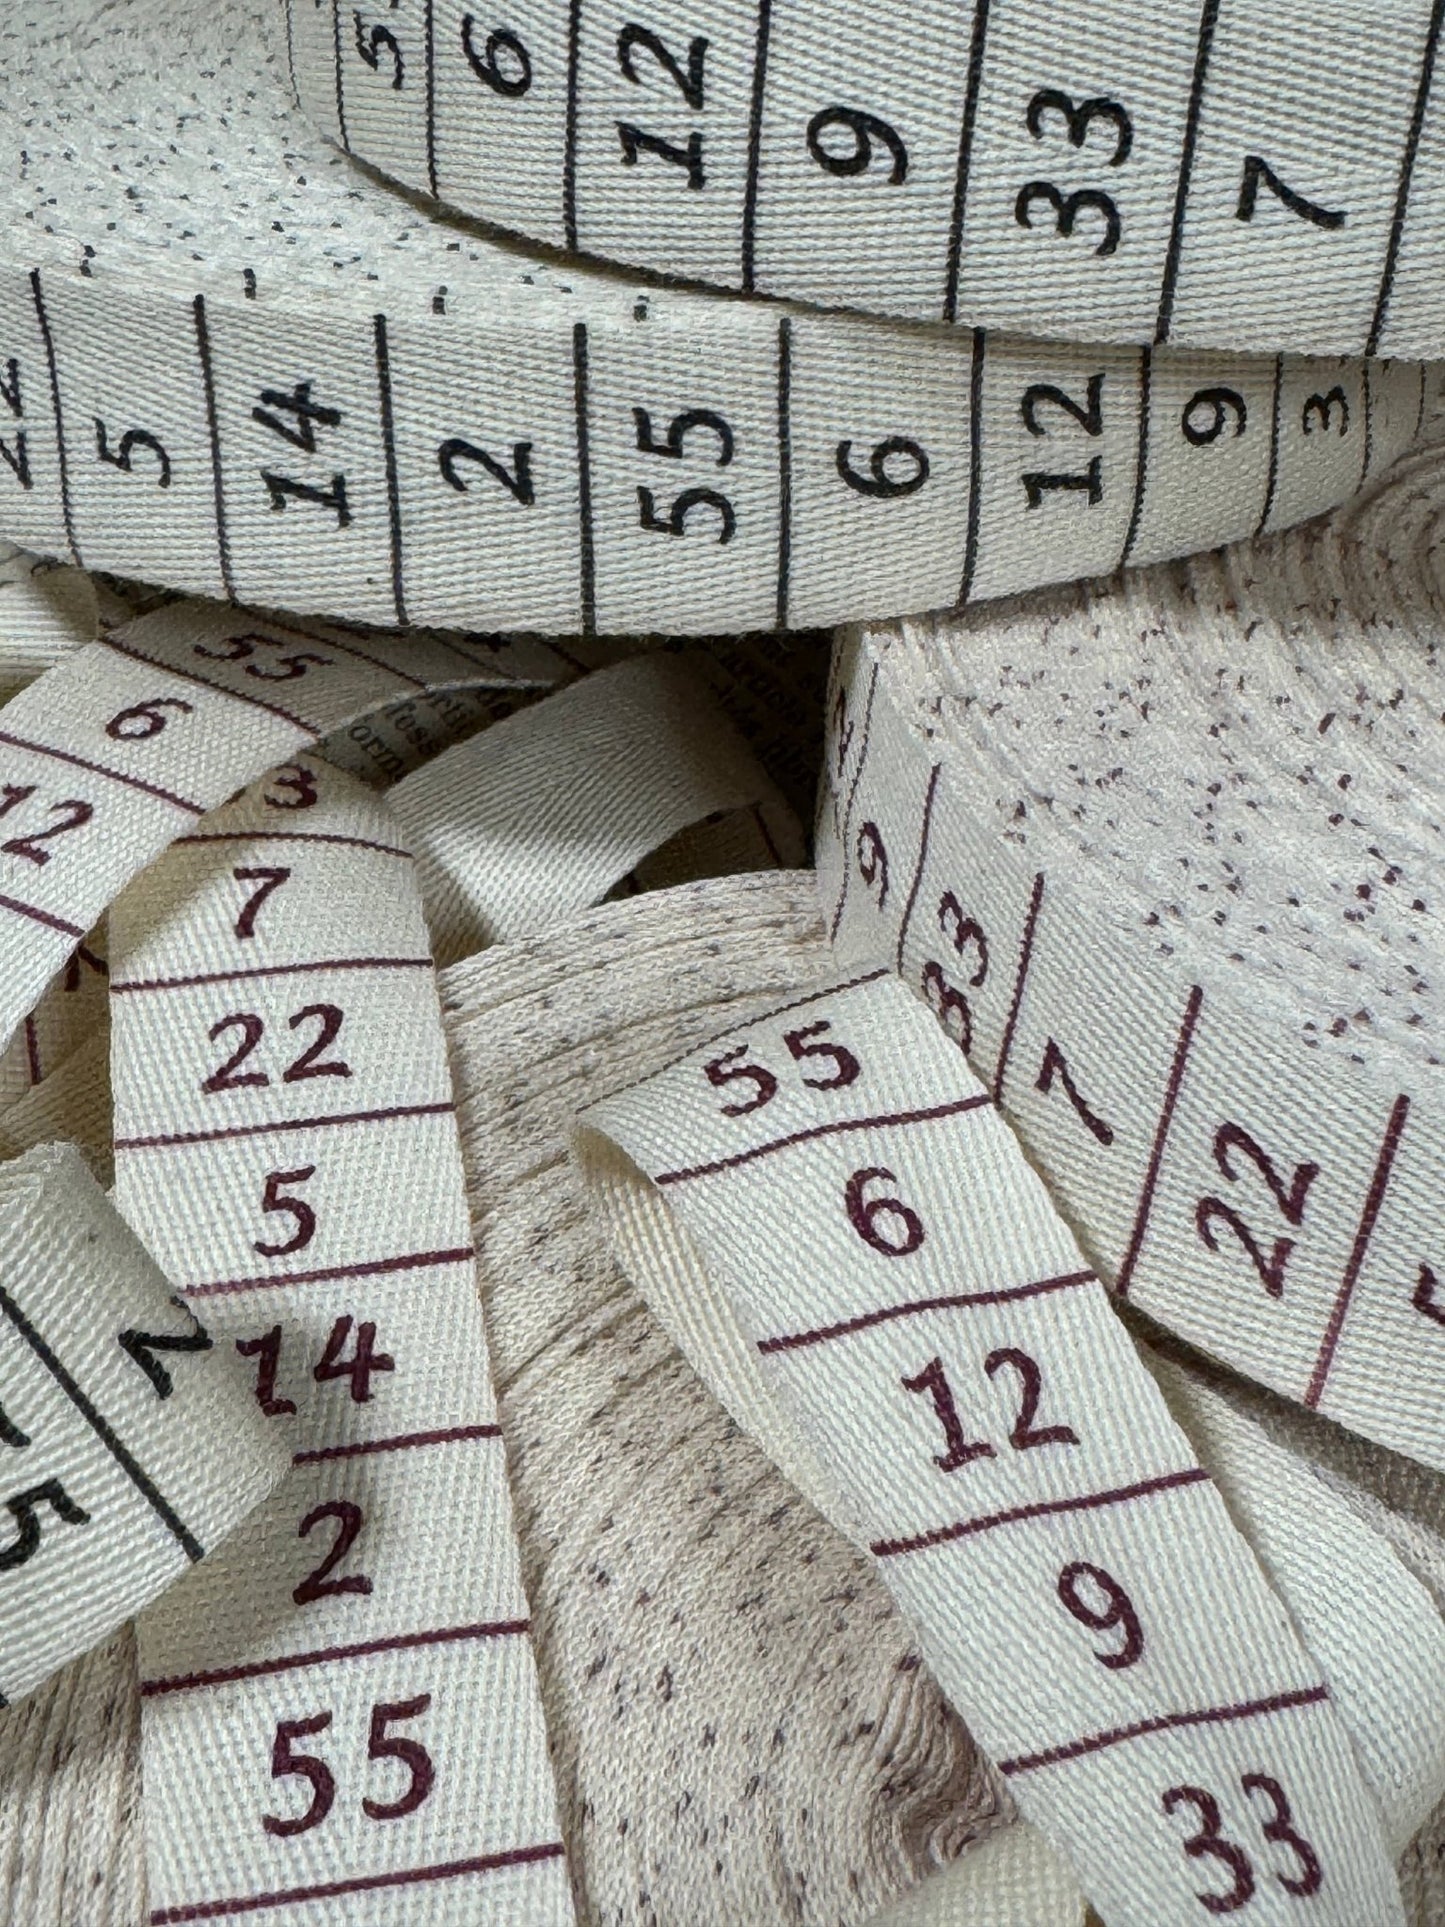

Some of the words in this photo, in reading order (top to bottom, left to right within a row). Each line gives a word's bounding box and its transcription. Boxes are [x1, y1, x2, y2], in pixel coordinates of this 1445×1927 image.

[460, 13, 533, 99] 6
[614, 22, 711, 191] 12
[806, 105, 909, 186] 9
[1014, 87, 1134, 257] 33
[1234, 155, 1348, 231] 7
[92, 417, 173, 488] 5
[251, 380, 354, 528] 14
[1018, 372, 1106, 509] 12
[1181, 386, 1247, 447] 9
[437, 438, 536, 507] 2
[631, 407, 737, 545] 55
[835, 435, 930, 499] 6
[194, 633, 334, 682] 55
[105, 697, 193, 741] 6
[232, 867, 291, 940] 7
[857, 821, 889, 908] 9
[920, 890, 989, 1057] 33
[201, 1003, 353, 1095] 22
[703, 1020, 861, 1118] 55
[1034, 1037, 1115, 1146] 7
[253, 1165, 316, 1258] 5
[844, 1167, 925, 1257] 6
[1195, 1121, 1320, 1299] 22
[235, 1315, 395, 1418] 14
[901, 1347, 1081, 1473] 12
[292, 1500, 372, 1606] 2
[1056, 1561, 1144, 1670] 9
[262, 1693, 436, 1838] 55
[1161, 1772, 1323, 1914] 33
